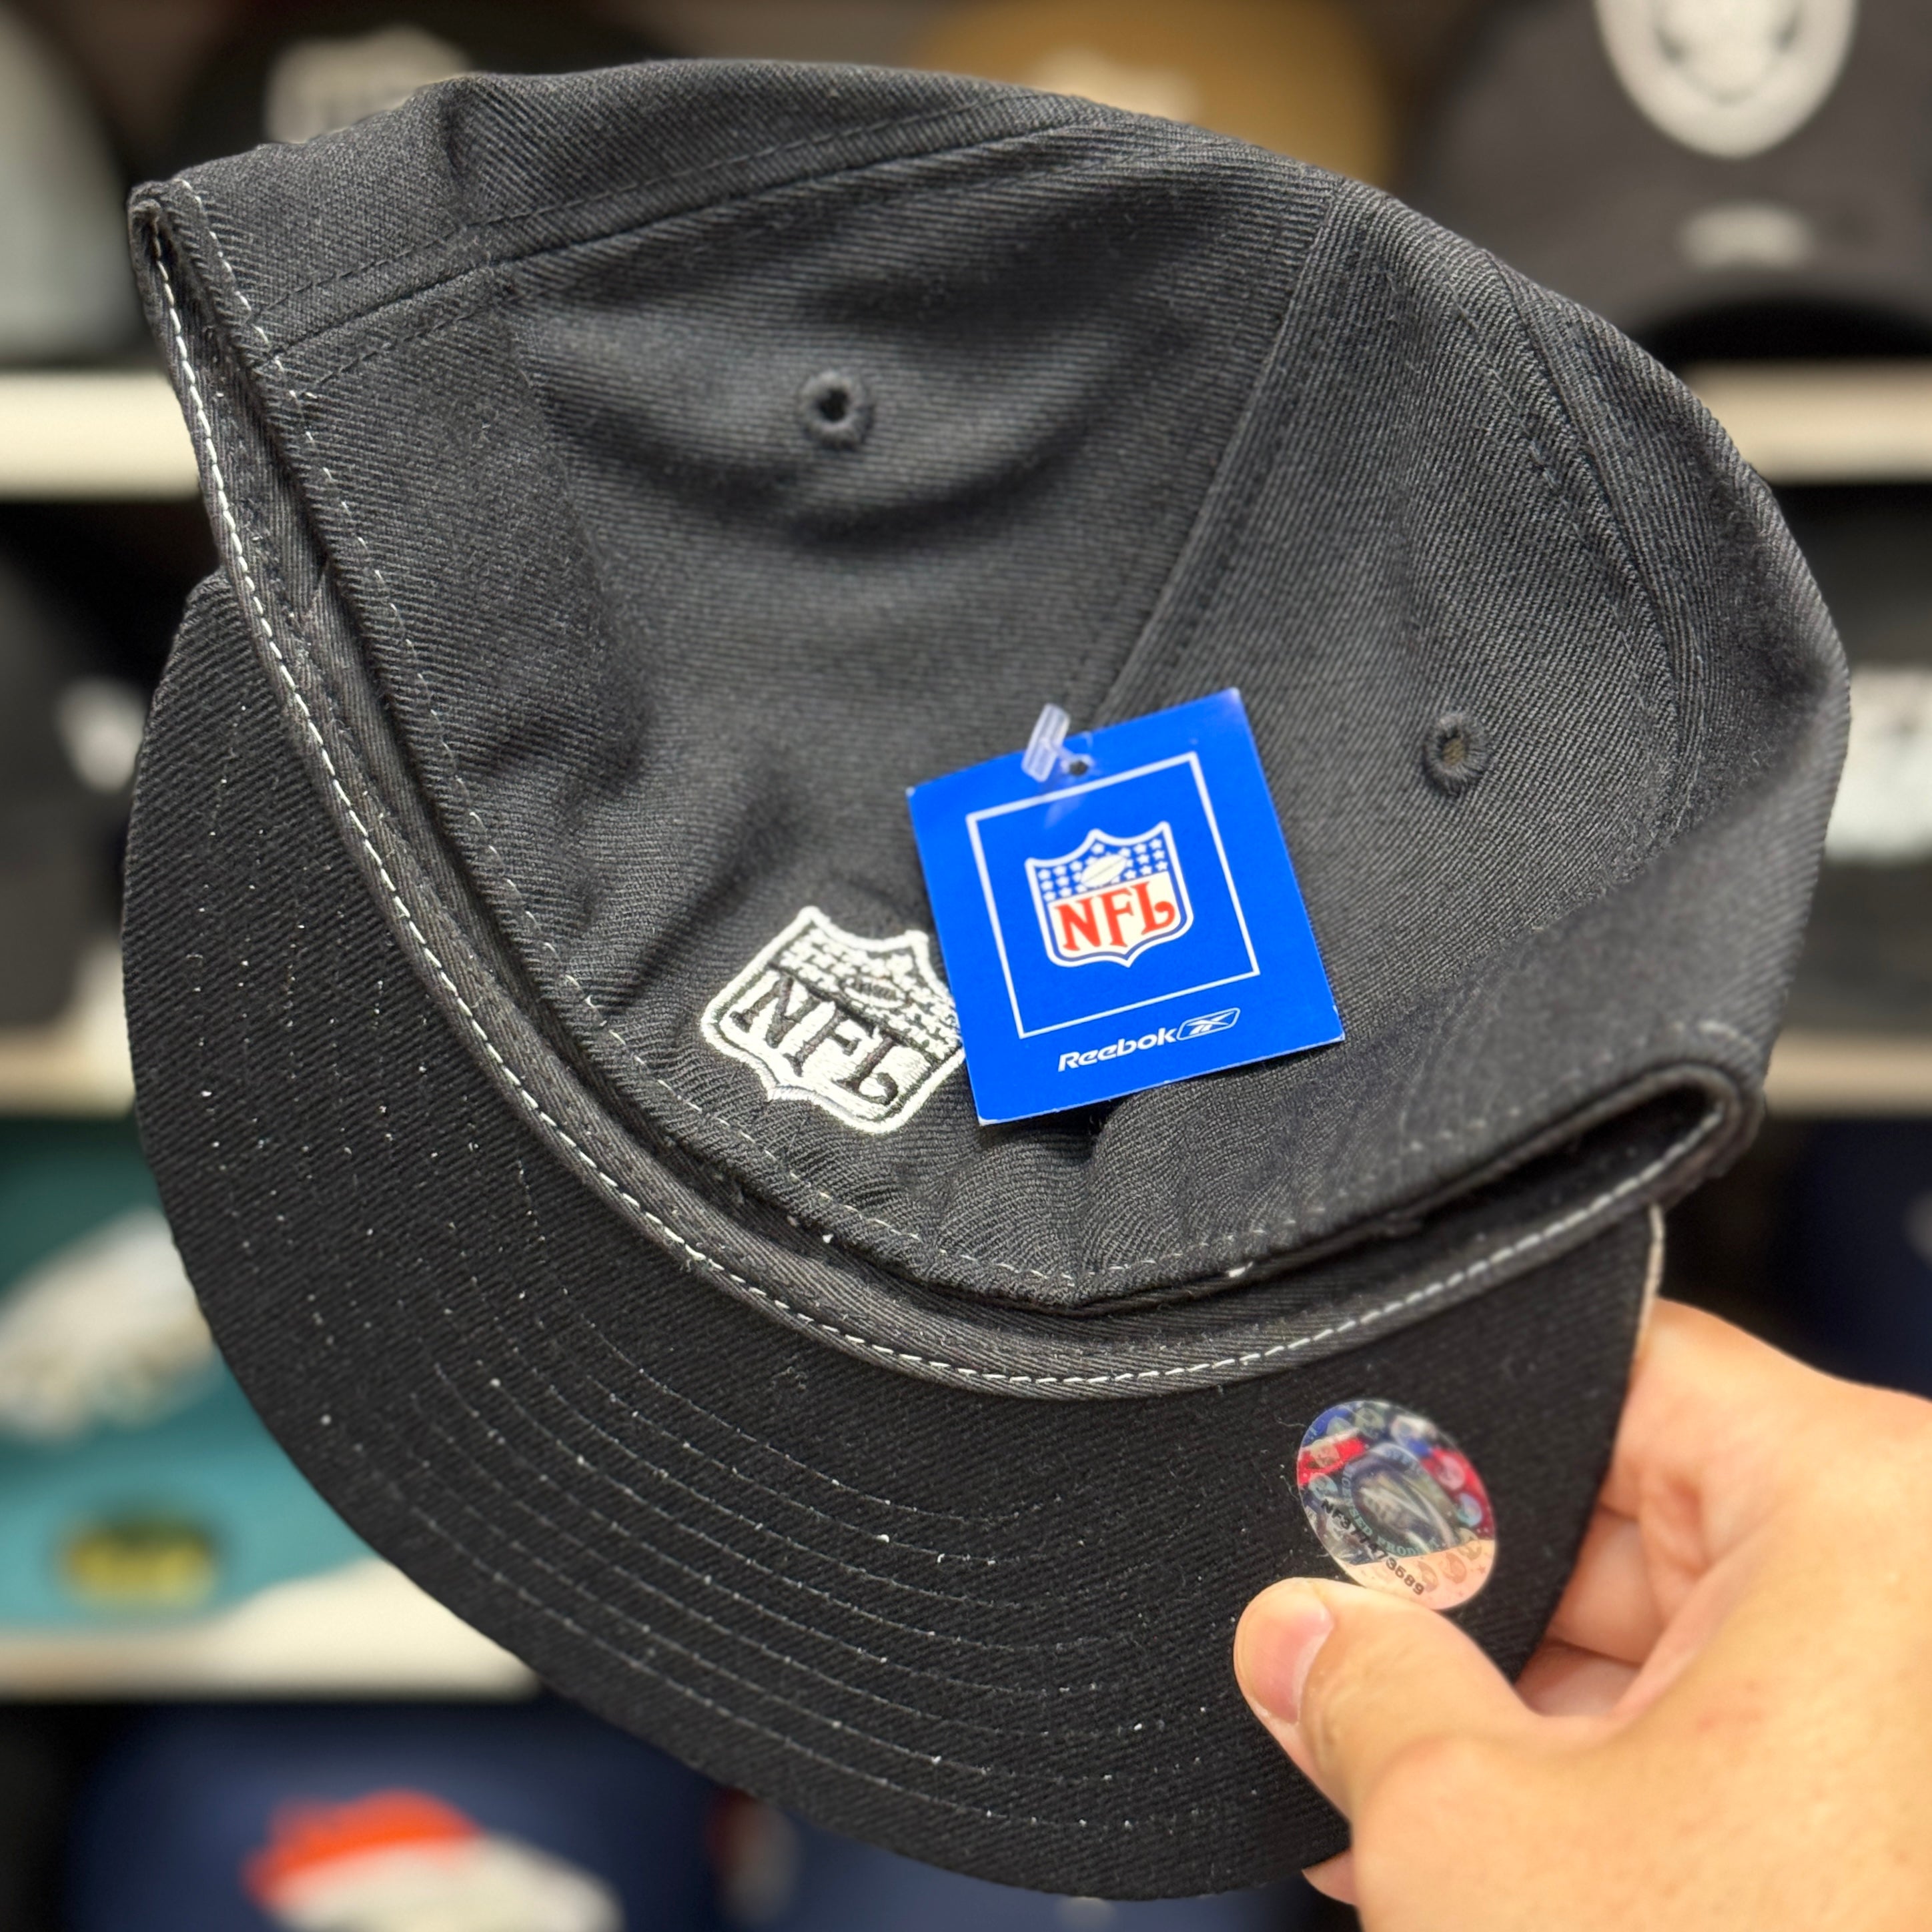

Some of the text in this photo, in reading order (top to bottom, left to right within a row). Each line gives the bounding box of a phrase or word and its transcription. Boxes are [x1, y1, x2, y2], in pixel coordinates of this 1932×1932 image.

[1054, 881, 1175, 951] NFL
[729, 971, 899, 1106] NFL
[1058, 1028, 1178, 1072] Reebok
